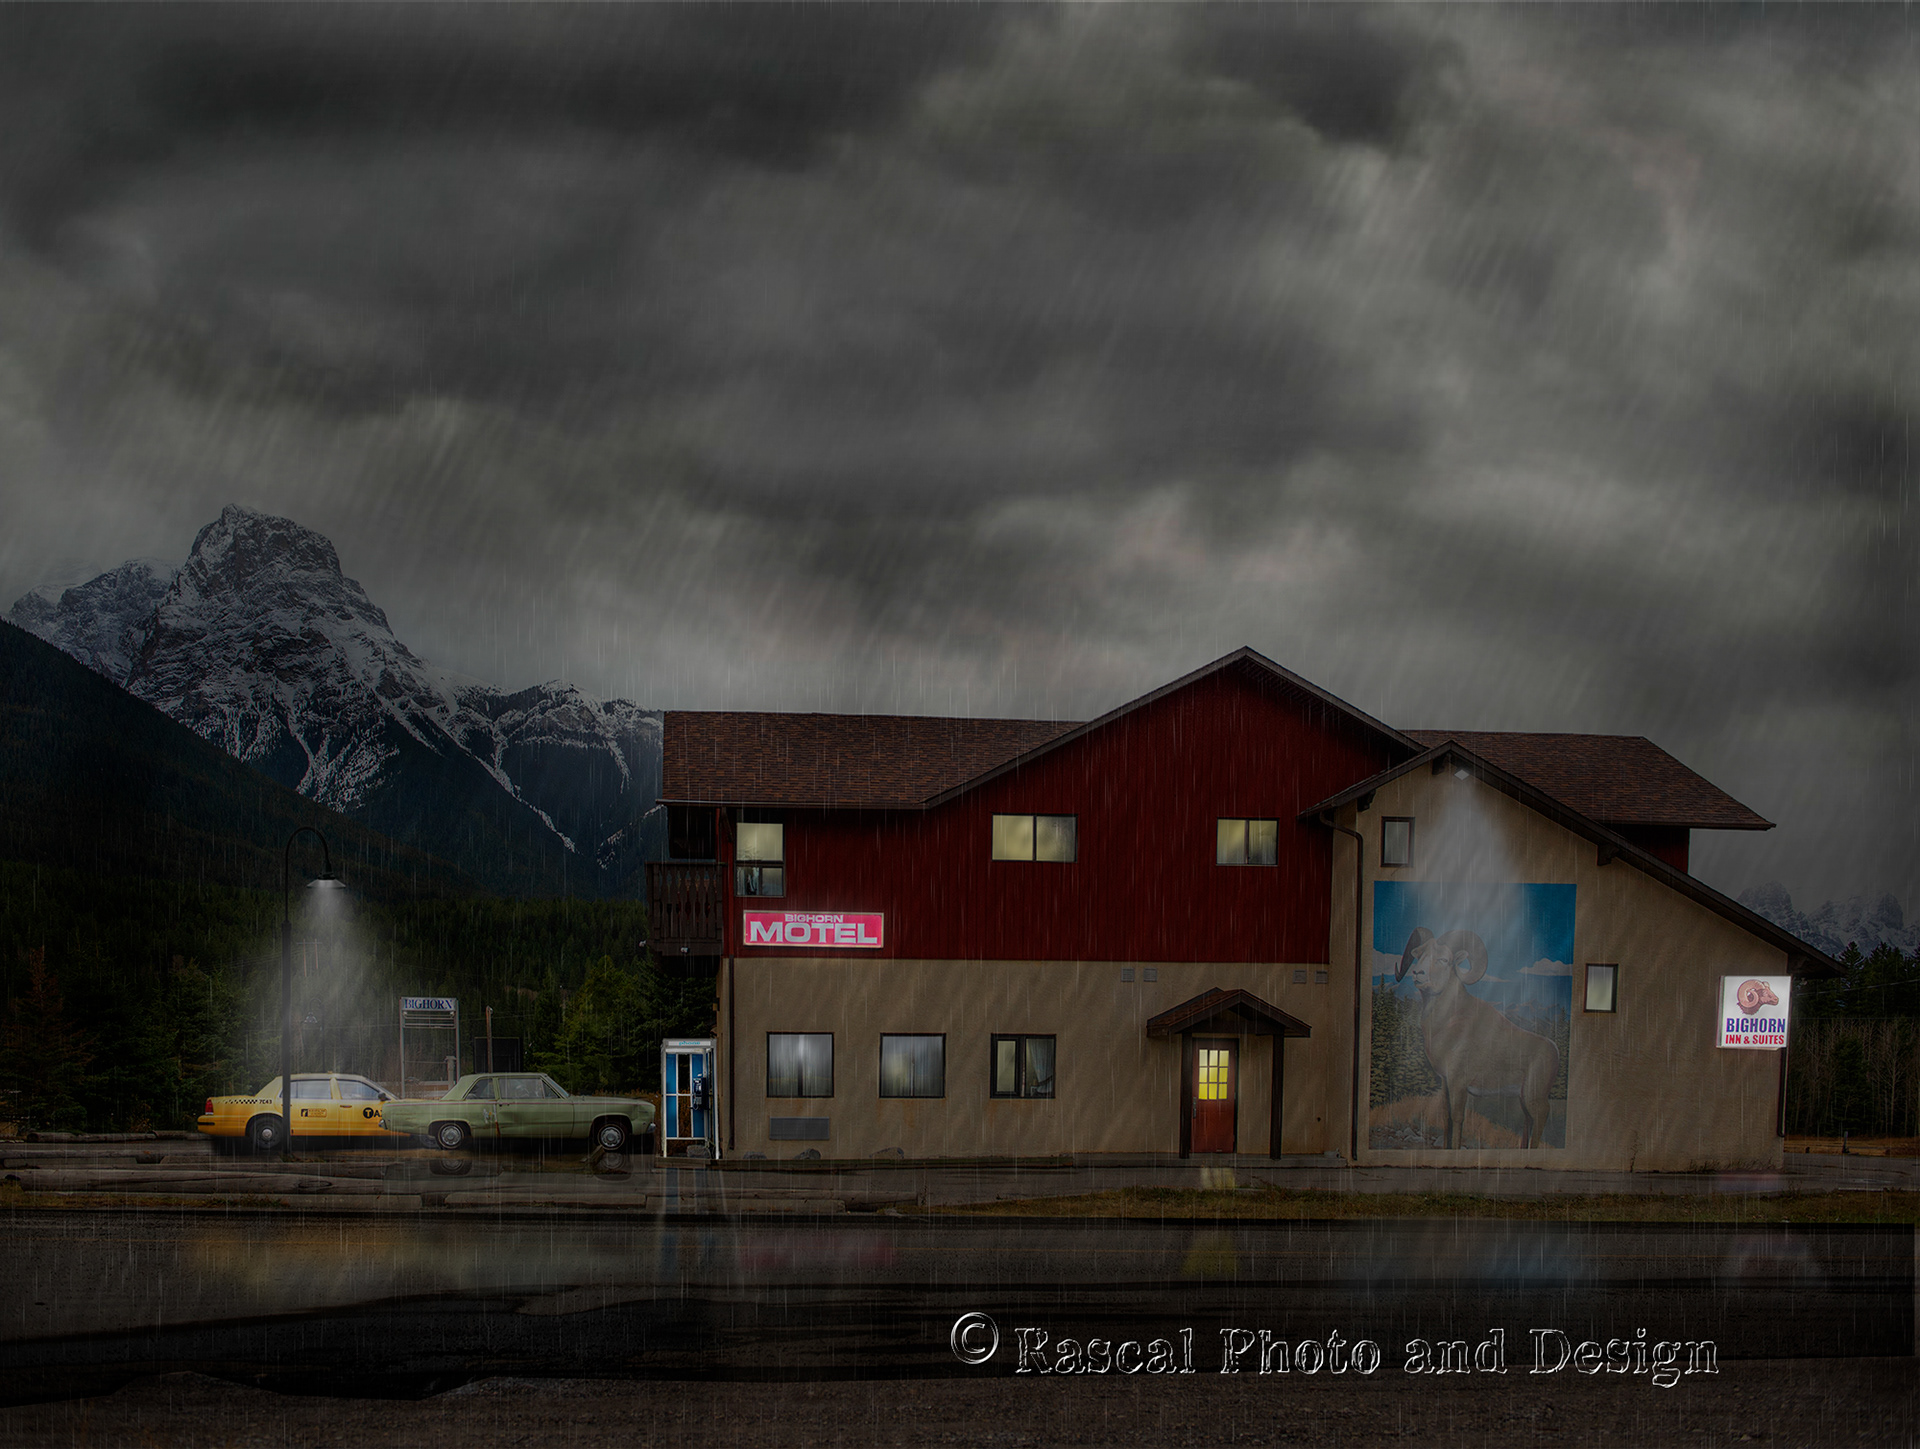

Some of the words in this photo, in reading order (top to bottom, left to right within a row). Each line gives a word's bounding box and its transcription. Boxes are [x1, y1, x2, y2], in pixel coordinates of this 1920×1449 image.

[784, 913, 844, 923] BIGHORN
[750, 921, 878, 944] MOTEL
[404, 998, 453, 1010] BIGHORN
[1726, 1017, 1786, 1033] BIGHORN
[1725, 1034, 1742, 1045] INN
[1743, 1036, 1750, 1044] &
[1752, 1034, 1785, 1045] SUITES
